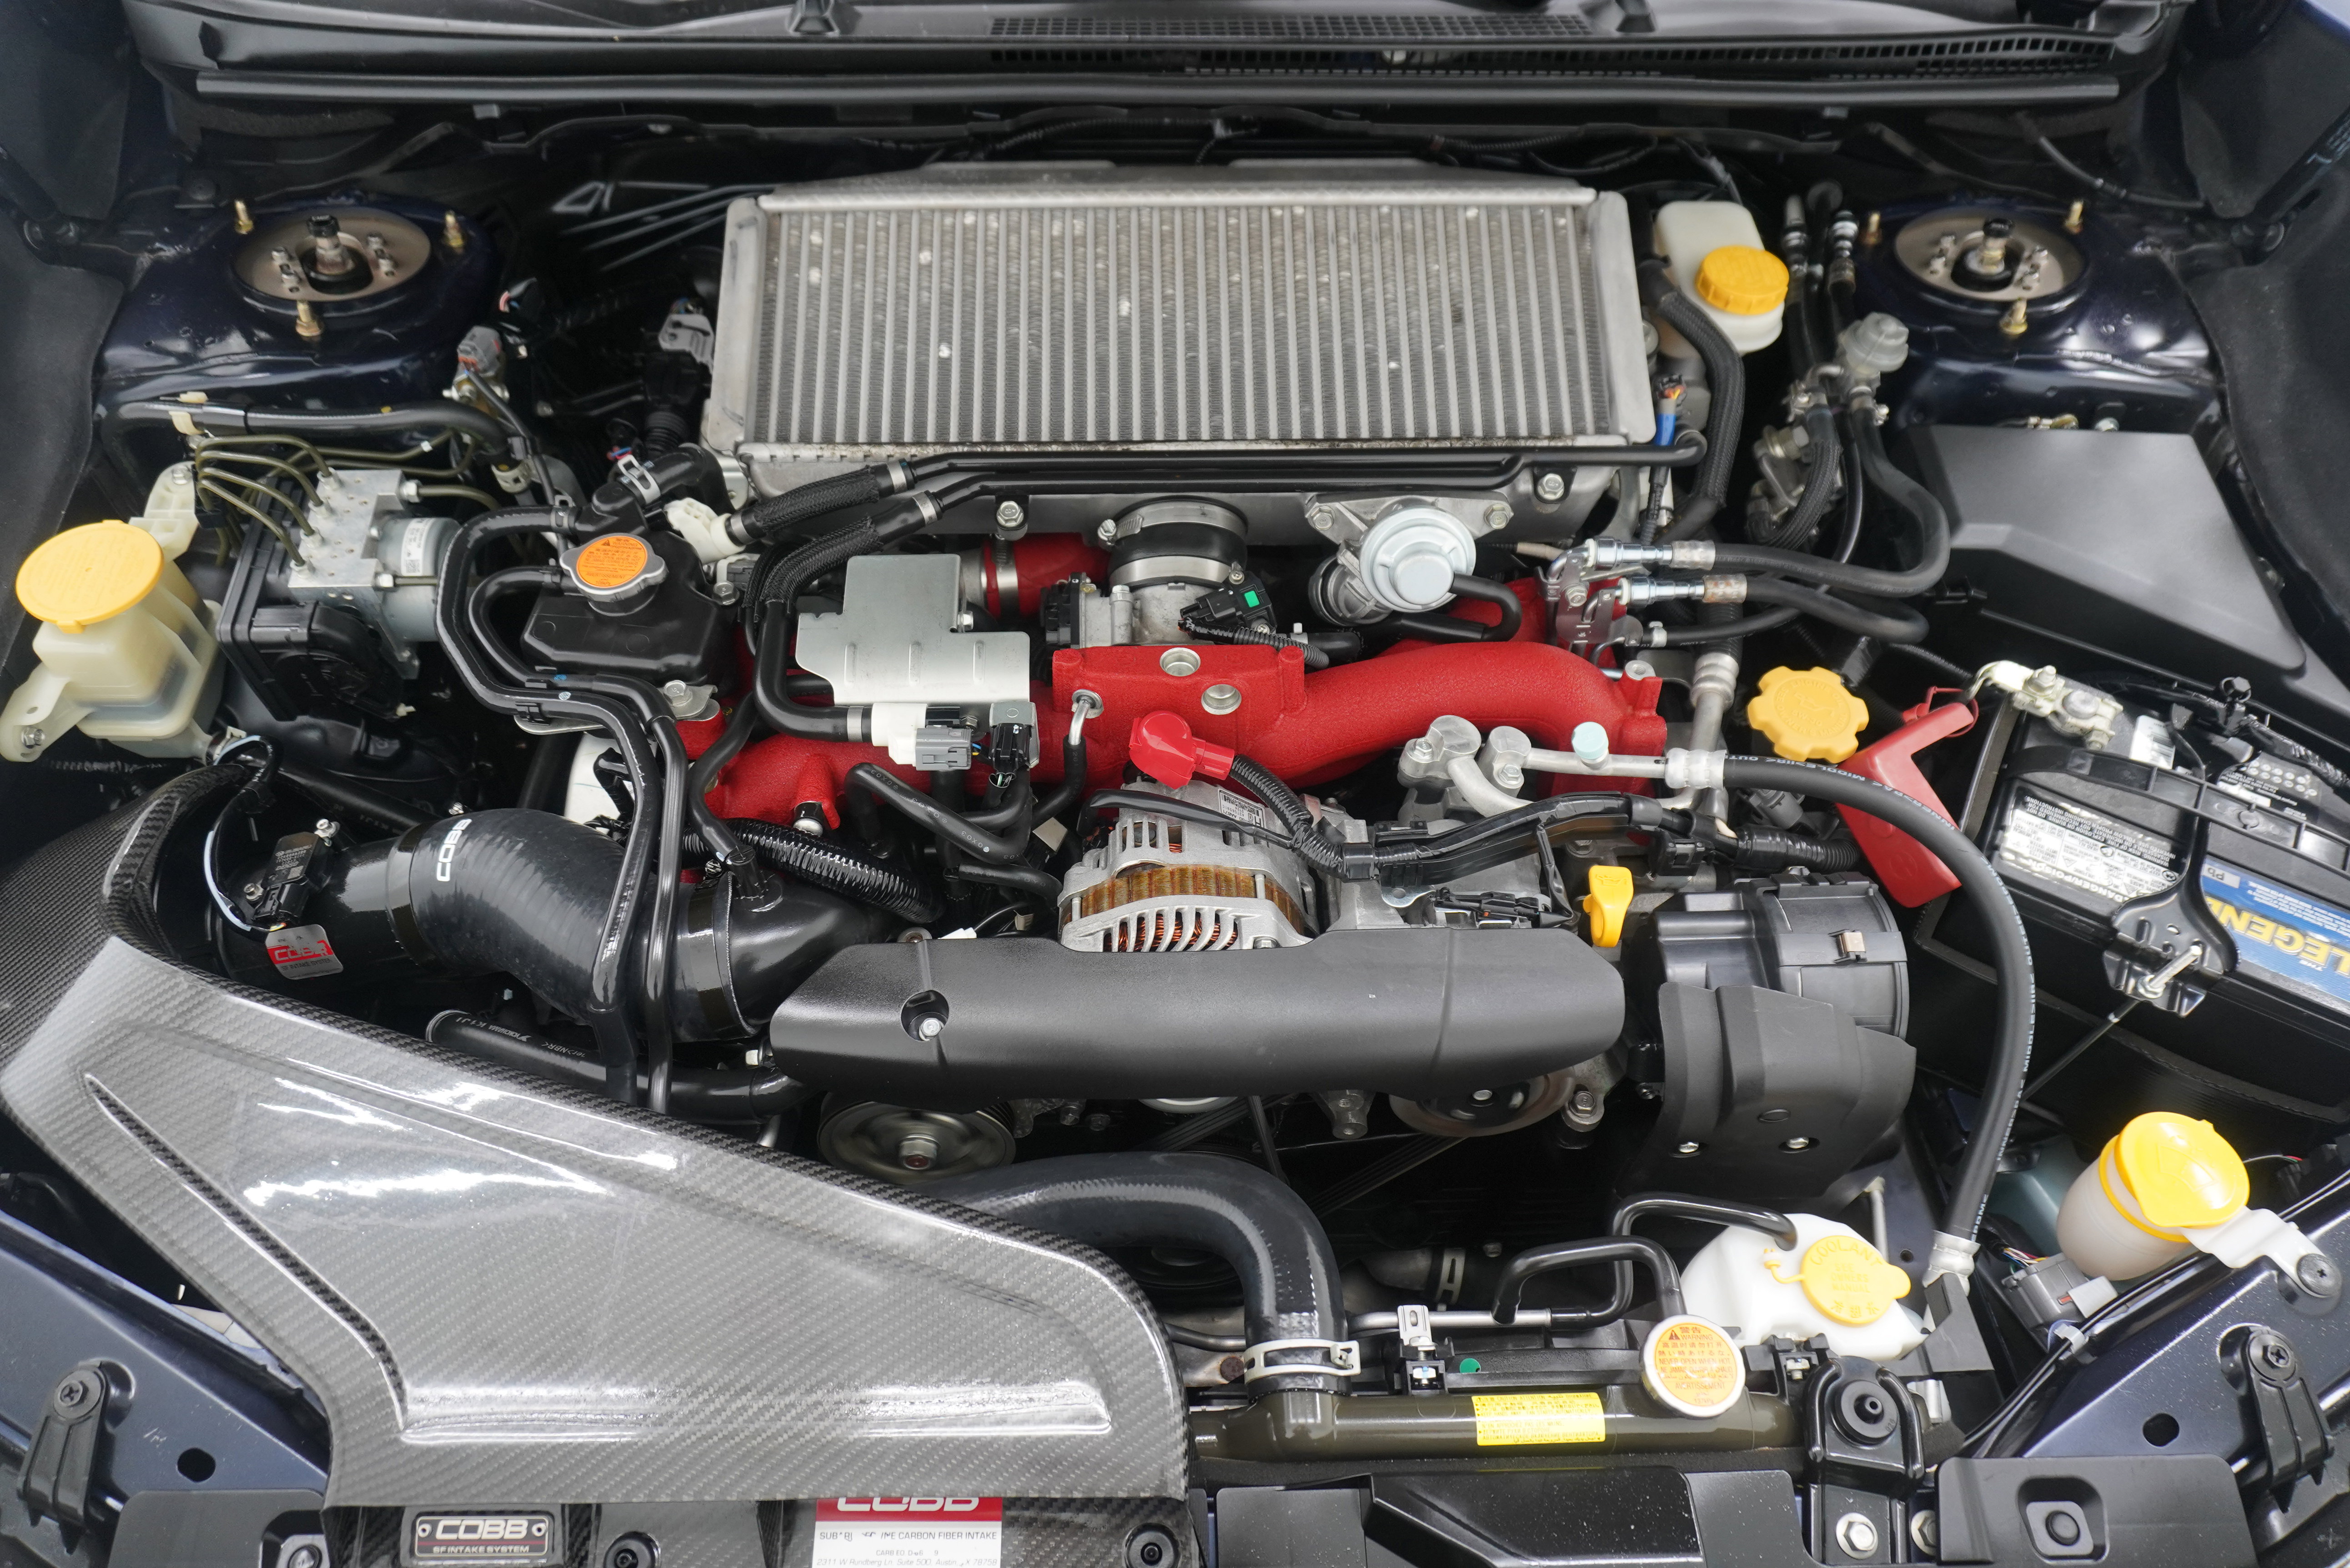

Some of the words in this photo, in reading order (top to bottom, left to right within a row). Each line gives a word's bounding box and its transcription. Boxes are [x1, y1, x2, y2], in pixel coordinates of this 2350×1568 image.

[1792, 680, 1832, 692] ENGINE
[1832, 693, 1844, 708] OIL
[1776, 687, 1789, 702] SEE
[1820, 713, 1848, 736] MANUAL
[1792, 710, 1823, 726] 5W-30
[2026, 807, 2038, 815] NOT
[2028, 802, 2039, 810] FOR
[2039, 806, 2079, 826] RECOMMENDED
[2064, 811, 2091, 826] CHARGING
[2080, 823, 2091, 831] NOT
[2091, 822, 2113, 834] PROPER
[2075, 826, 2105, 842] EXPLOSION
[2113, 830, 2136, 843] FOLLOW
[437, 819, 472, 881] COBB
[2127, 846, 2141, 856] RISK
[2132, 843, 2170, 862] DISASSEMBLE
[2149, 845, 2176, 859] INVERTED
[2117, 852, 2139, 864] CHILDREN
[2208, 867, 2225, 881] Pb
[1810, 1239, 1883, 1266] COOLANT
[1835, 1263, 1854, 1272] SEE
[1831, 1273, 1869, 1283] OWNERS
[1832, 1282, 1870, 1293] MANUAL
[436, 1519, 528, 1539] COBB
[820, 1532, 853, 1541] SUBR
[849, 1558, 882, 1567] Rundberg
